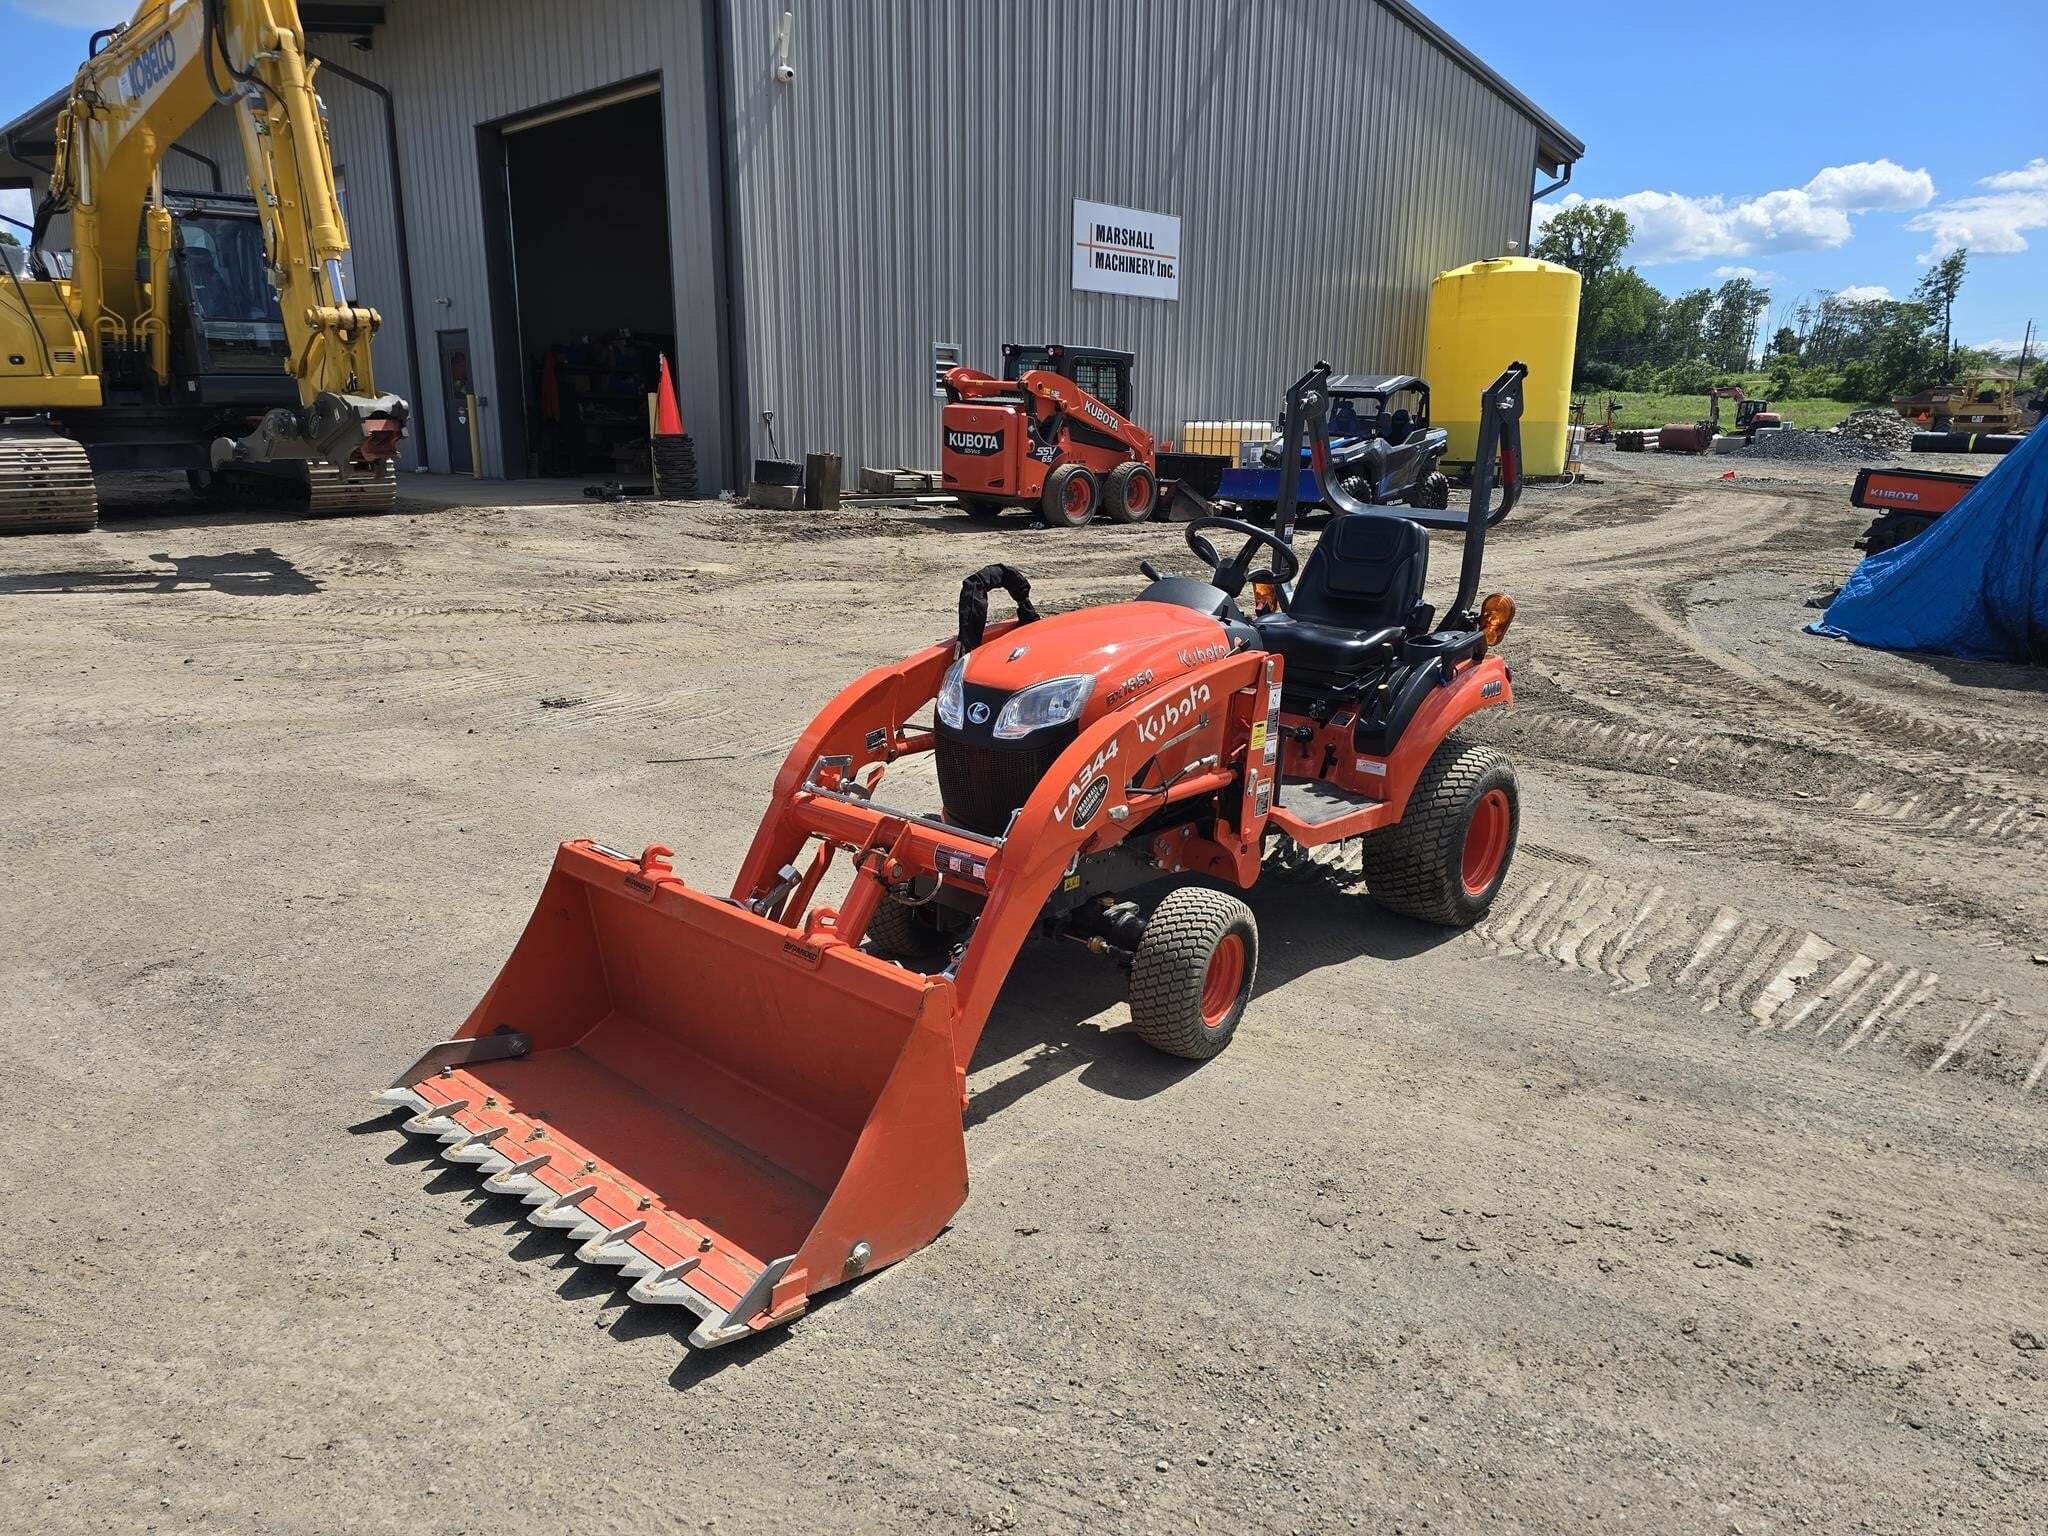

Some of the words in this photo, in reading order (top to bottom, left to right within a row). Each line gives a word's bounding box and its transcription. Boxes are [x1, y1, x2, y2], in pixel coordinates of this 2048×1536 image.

[128, 31, 176, 97] KOBELCO
[1096, 224, 1154, 250] MARSHALL
[1095, 252, 1155, 277] MACHINERY,
[1157, 260, 1176, 279] Inc.
[1084, 401, 1119, 432] KUBOTA
[1971, 415, 1985, 423] CAT
[949, 432, 999, 449] KUBOTA
[1036, 446, 1057, 456] SSV
[1871, 488, 1920, 501] KUBOTA
[1178, 641, 1227, 667] Kubota
[1480, 680, 1502, 698] 4WD
[1138, 684, 1211, 743] Kubota
[1053, 739, 1119, 822] LA344
